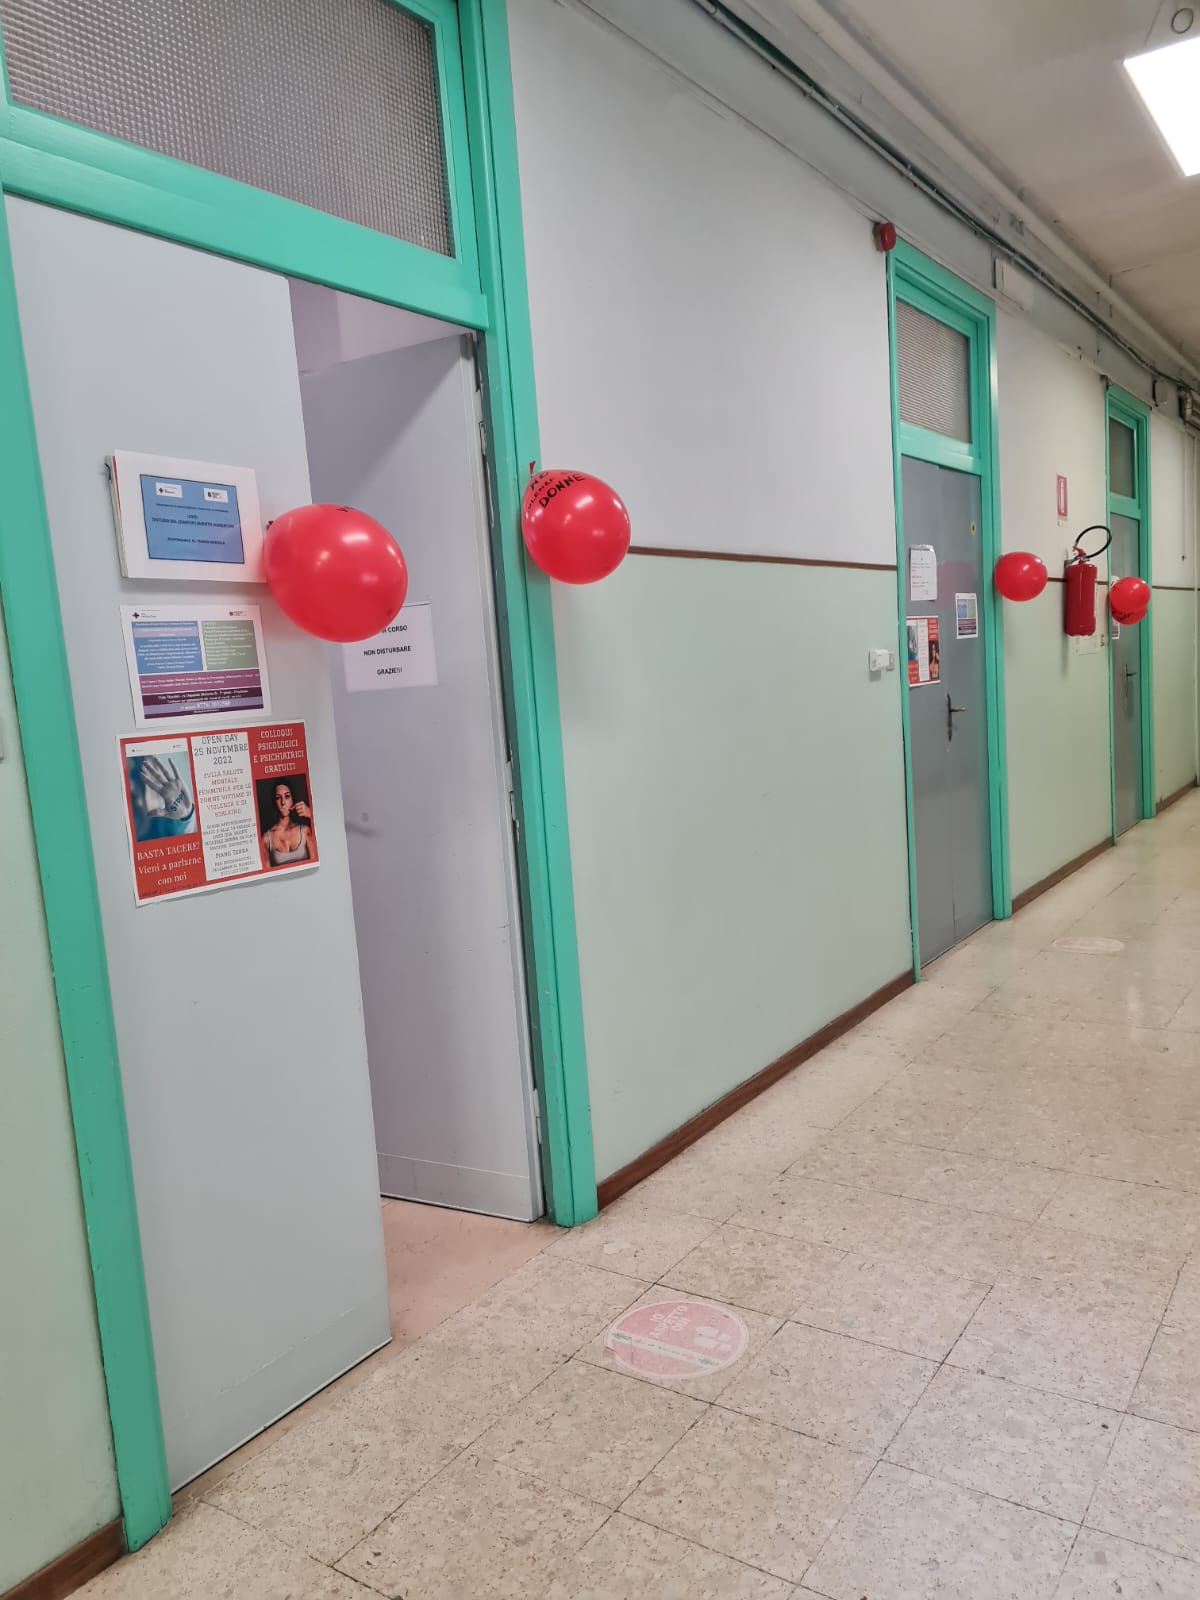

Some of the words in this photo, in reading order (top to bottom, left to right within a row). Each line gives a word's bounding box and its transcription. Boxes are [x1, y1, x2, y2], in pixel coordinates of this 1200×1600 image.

[538, 473, 585, 508] DONNE
[387, 624, 408, 633] CORSO
[363, 649, 376, 657] NON
[376, 645, 412, 655] DISTURBARE
[201, 735, 222, 745] OPEN
[224, 733, 239, 743] DAY
[260, 728, 293, 739] COLLOQUI
[194, 747, 204, 757] 25
[206, 743, 249, 755] NOVEMBRE
[257, 739, 299, 751] PSICOLOGICI
[212, 755, 233, 765] 2022
[253, 754, 258, 764] E
[260, 750, 305, 763] PSICHIATRICI
[264, 762, 296, 774] GRATUITI
[136, 848, 165, 861] BASTA
[165, 841, 200, 856] TACERE!
[138, 863, 160, 875] Vieni
[168, 856, 202, 872] parlarne
[157, 877, 172, 886] con
[174, 871, 187, 883] noi
